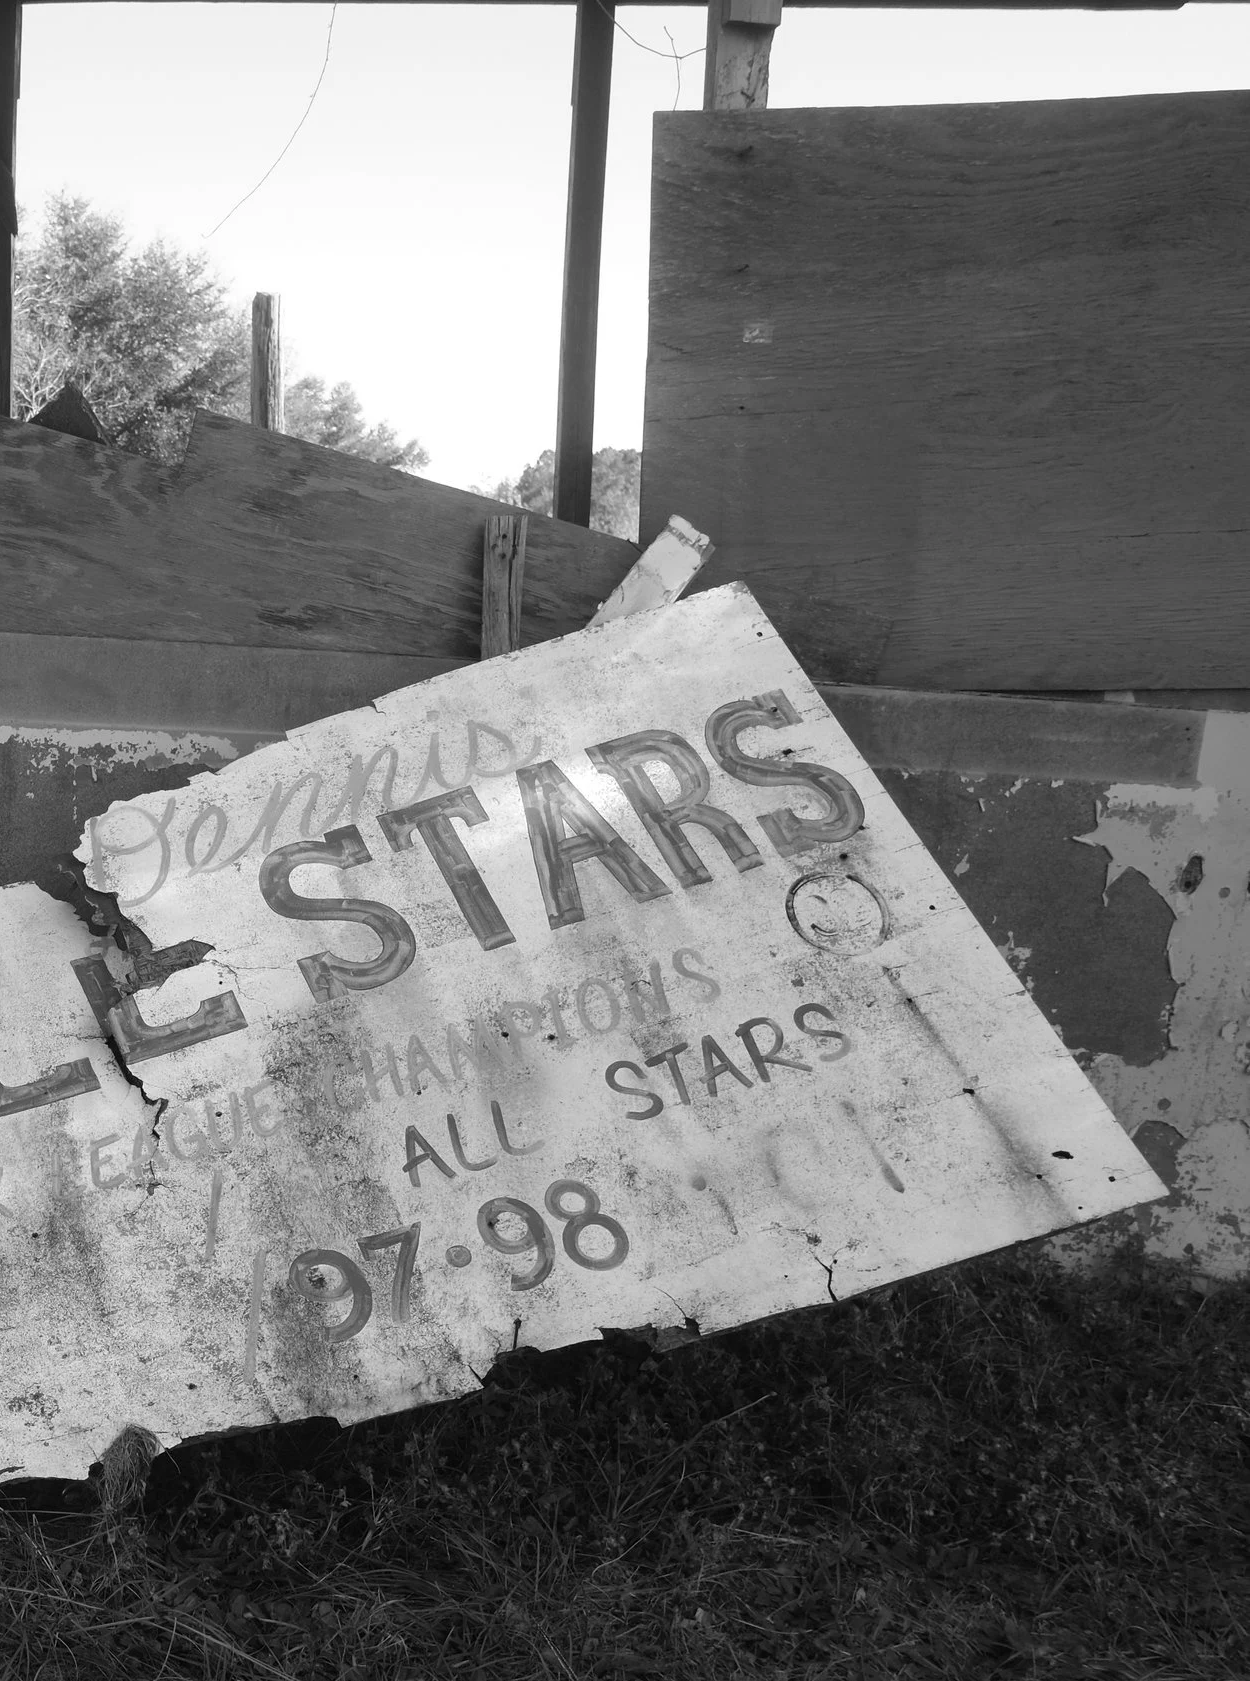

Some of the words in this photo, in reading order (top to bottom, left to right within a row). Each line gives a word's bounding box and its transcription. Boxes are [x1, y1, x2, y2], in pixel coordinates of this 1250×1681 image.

[89, 709, 541, 907] Dennis
[258, 688, 866, 1004] STARS
[402, 1100, 547, 1187] ALL
[605, 1002, 851, 1121] STARS
